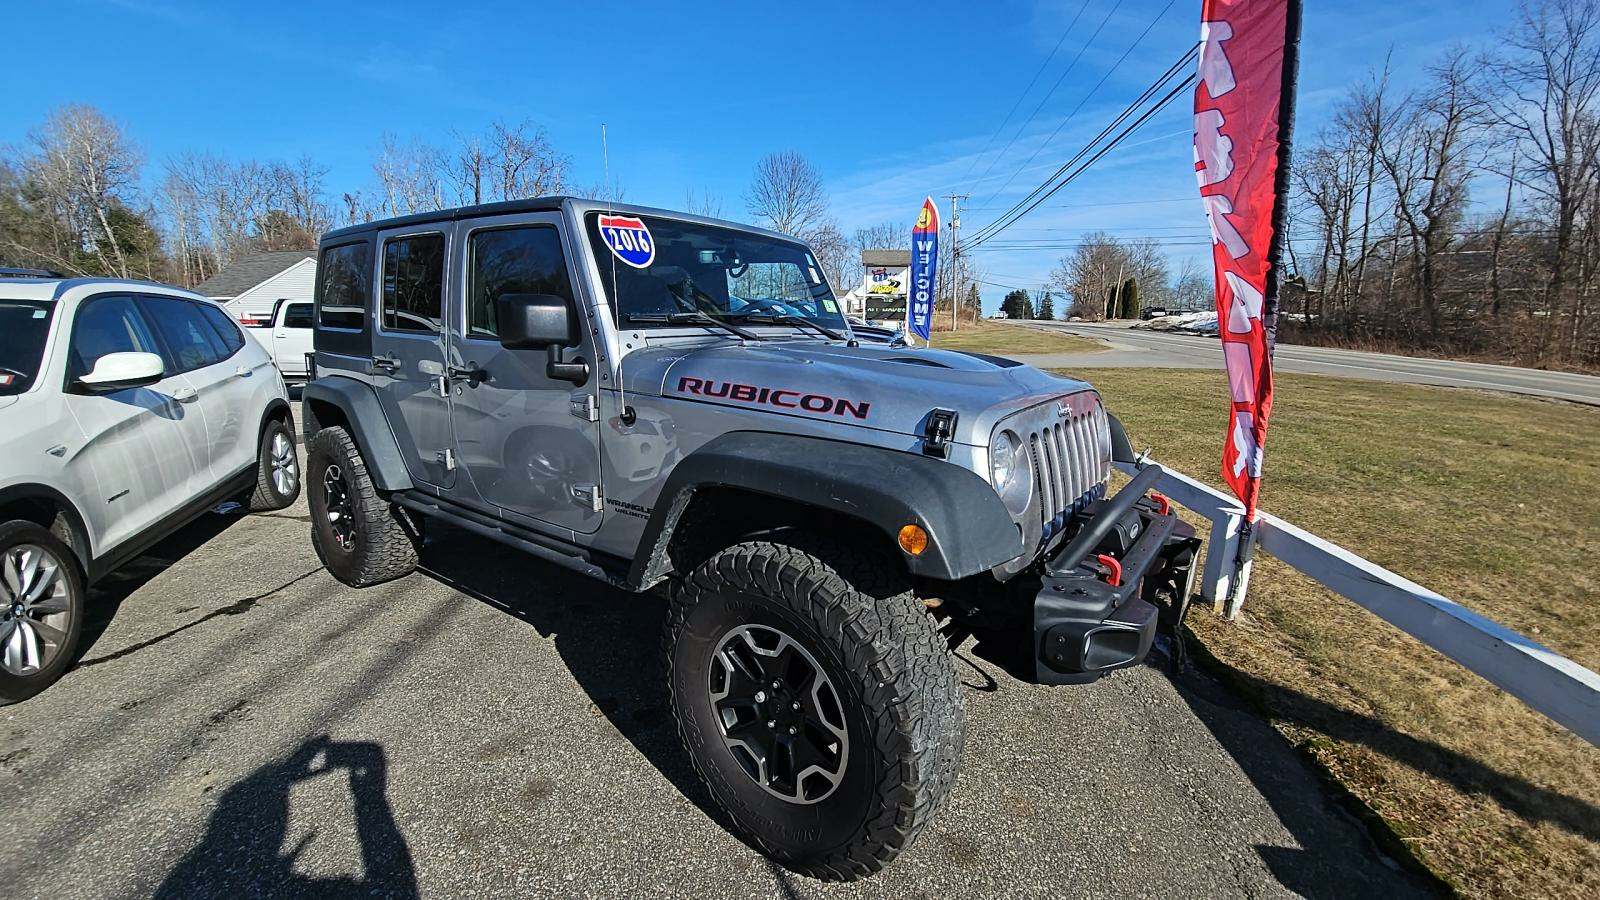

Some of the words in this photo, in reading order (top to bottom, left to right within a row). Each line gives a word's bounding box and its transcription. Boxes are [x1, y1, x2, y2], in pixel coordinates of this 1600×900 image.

[608, 228, 650, 253] 2016
[677, 376, 872, 420] RUBICON
[606, 497, 657, 515] WRANGLE
[615, 508, 651, 520] UNLIMITE
